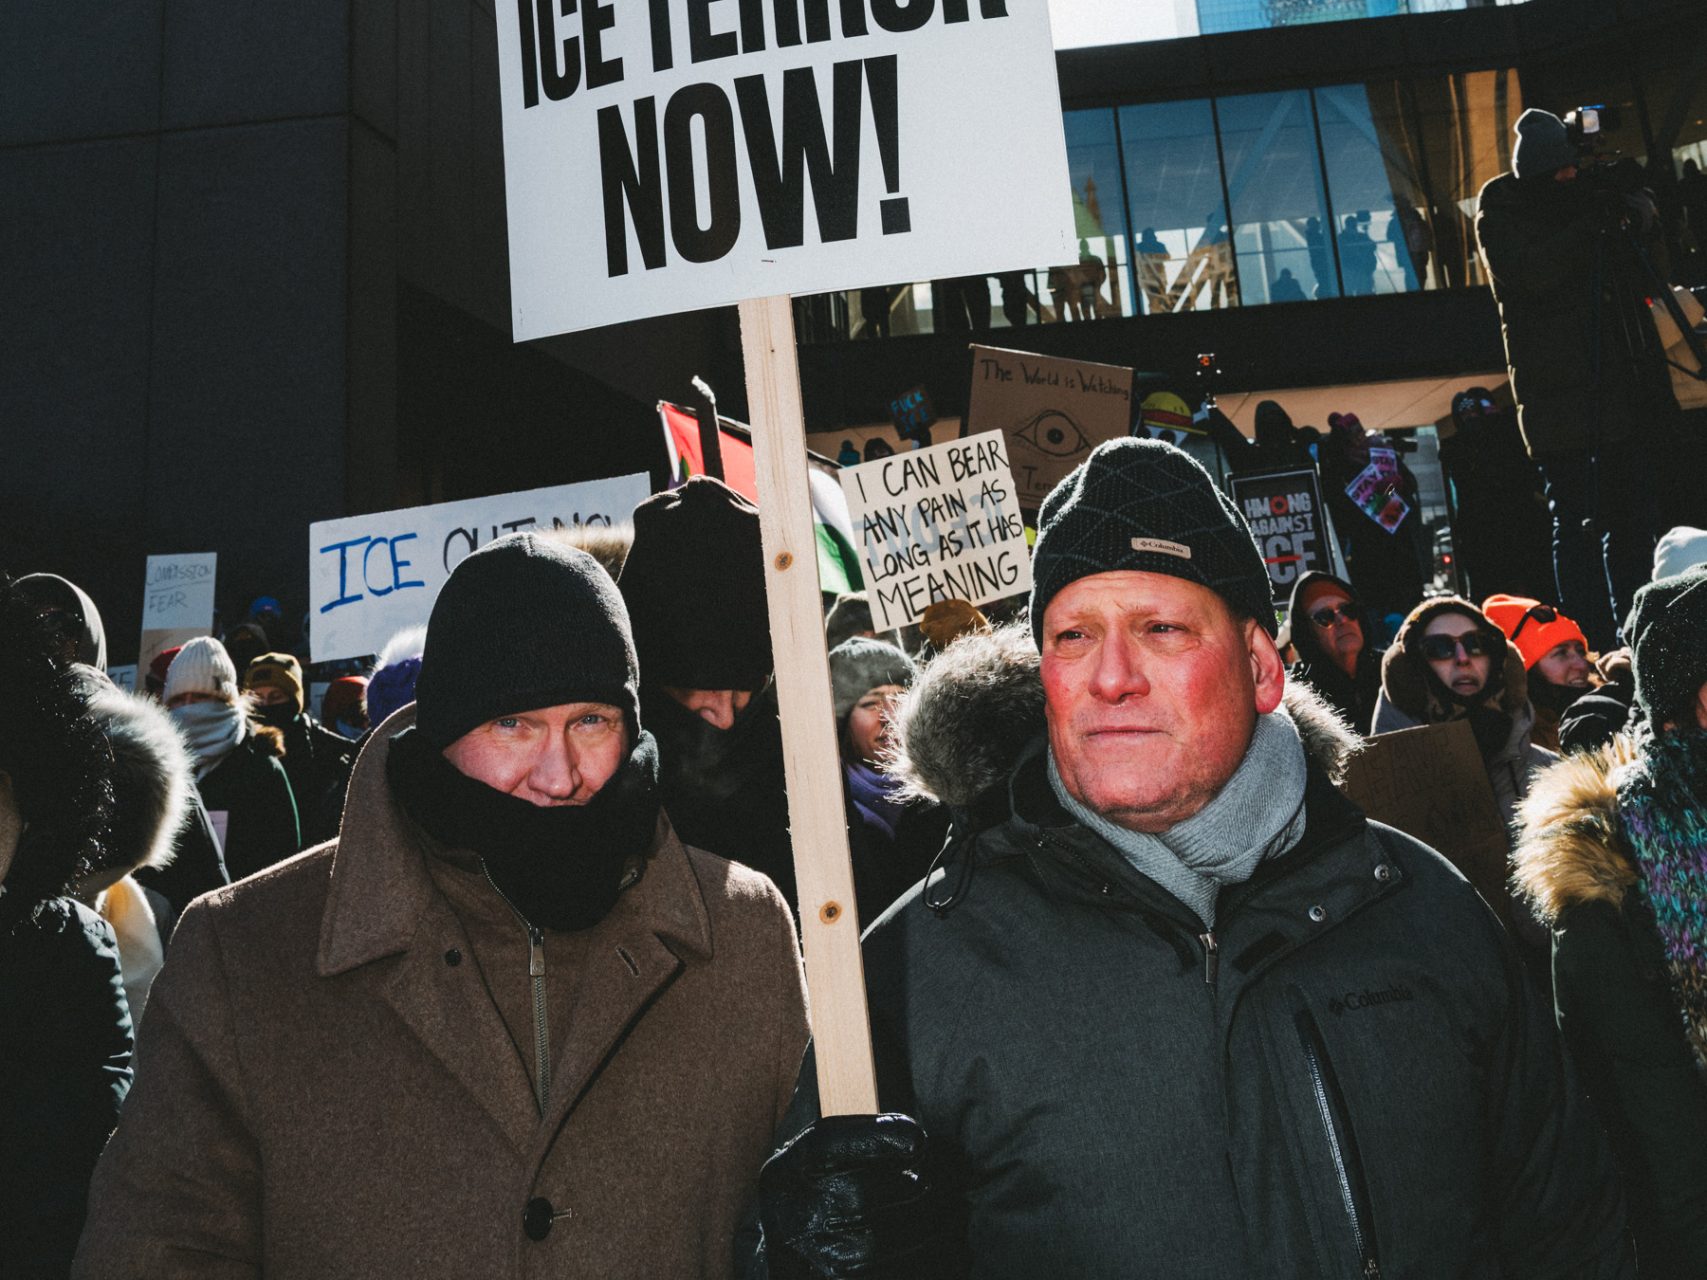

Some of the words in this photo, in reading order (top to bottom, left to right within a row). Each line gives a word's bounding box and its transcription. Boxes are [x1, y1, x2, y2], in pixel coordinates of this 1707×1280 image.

[598, 54, 911, 278] NOW!
[981, 359, 1013, 382] The
[1020, 362, 1060, 386] World
[1065, 375, 1075, 389] is
[1076, 369, 1130, 401] Watching
[856, 472, 867, 503] I
[882, 454, 940, 497] CAN
[947, 439, 1009, 482] BEAR
[863, 504, 911, 547] ANY
[917, 488, 968, 527] PAIN
[980, 479, 1007, 509] AS
[1244, 492, 1312, 519] HMONG
[1251, 513, 1313, 537] AGAINST
[320, 532, 425, 614] ICE
[867, 543, 931, 582] LONG
[939, 530, 964, 561] AS
[966, 520, 985, 550] IT
[988, 513, 1022, 544] HAS
[148, 590, 188, 613] FEAR
[876, 551, 1018, 627] MEANING
[1344, 982, 1413, 1011] Columbia
